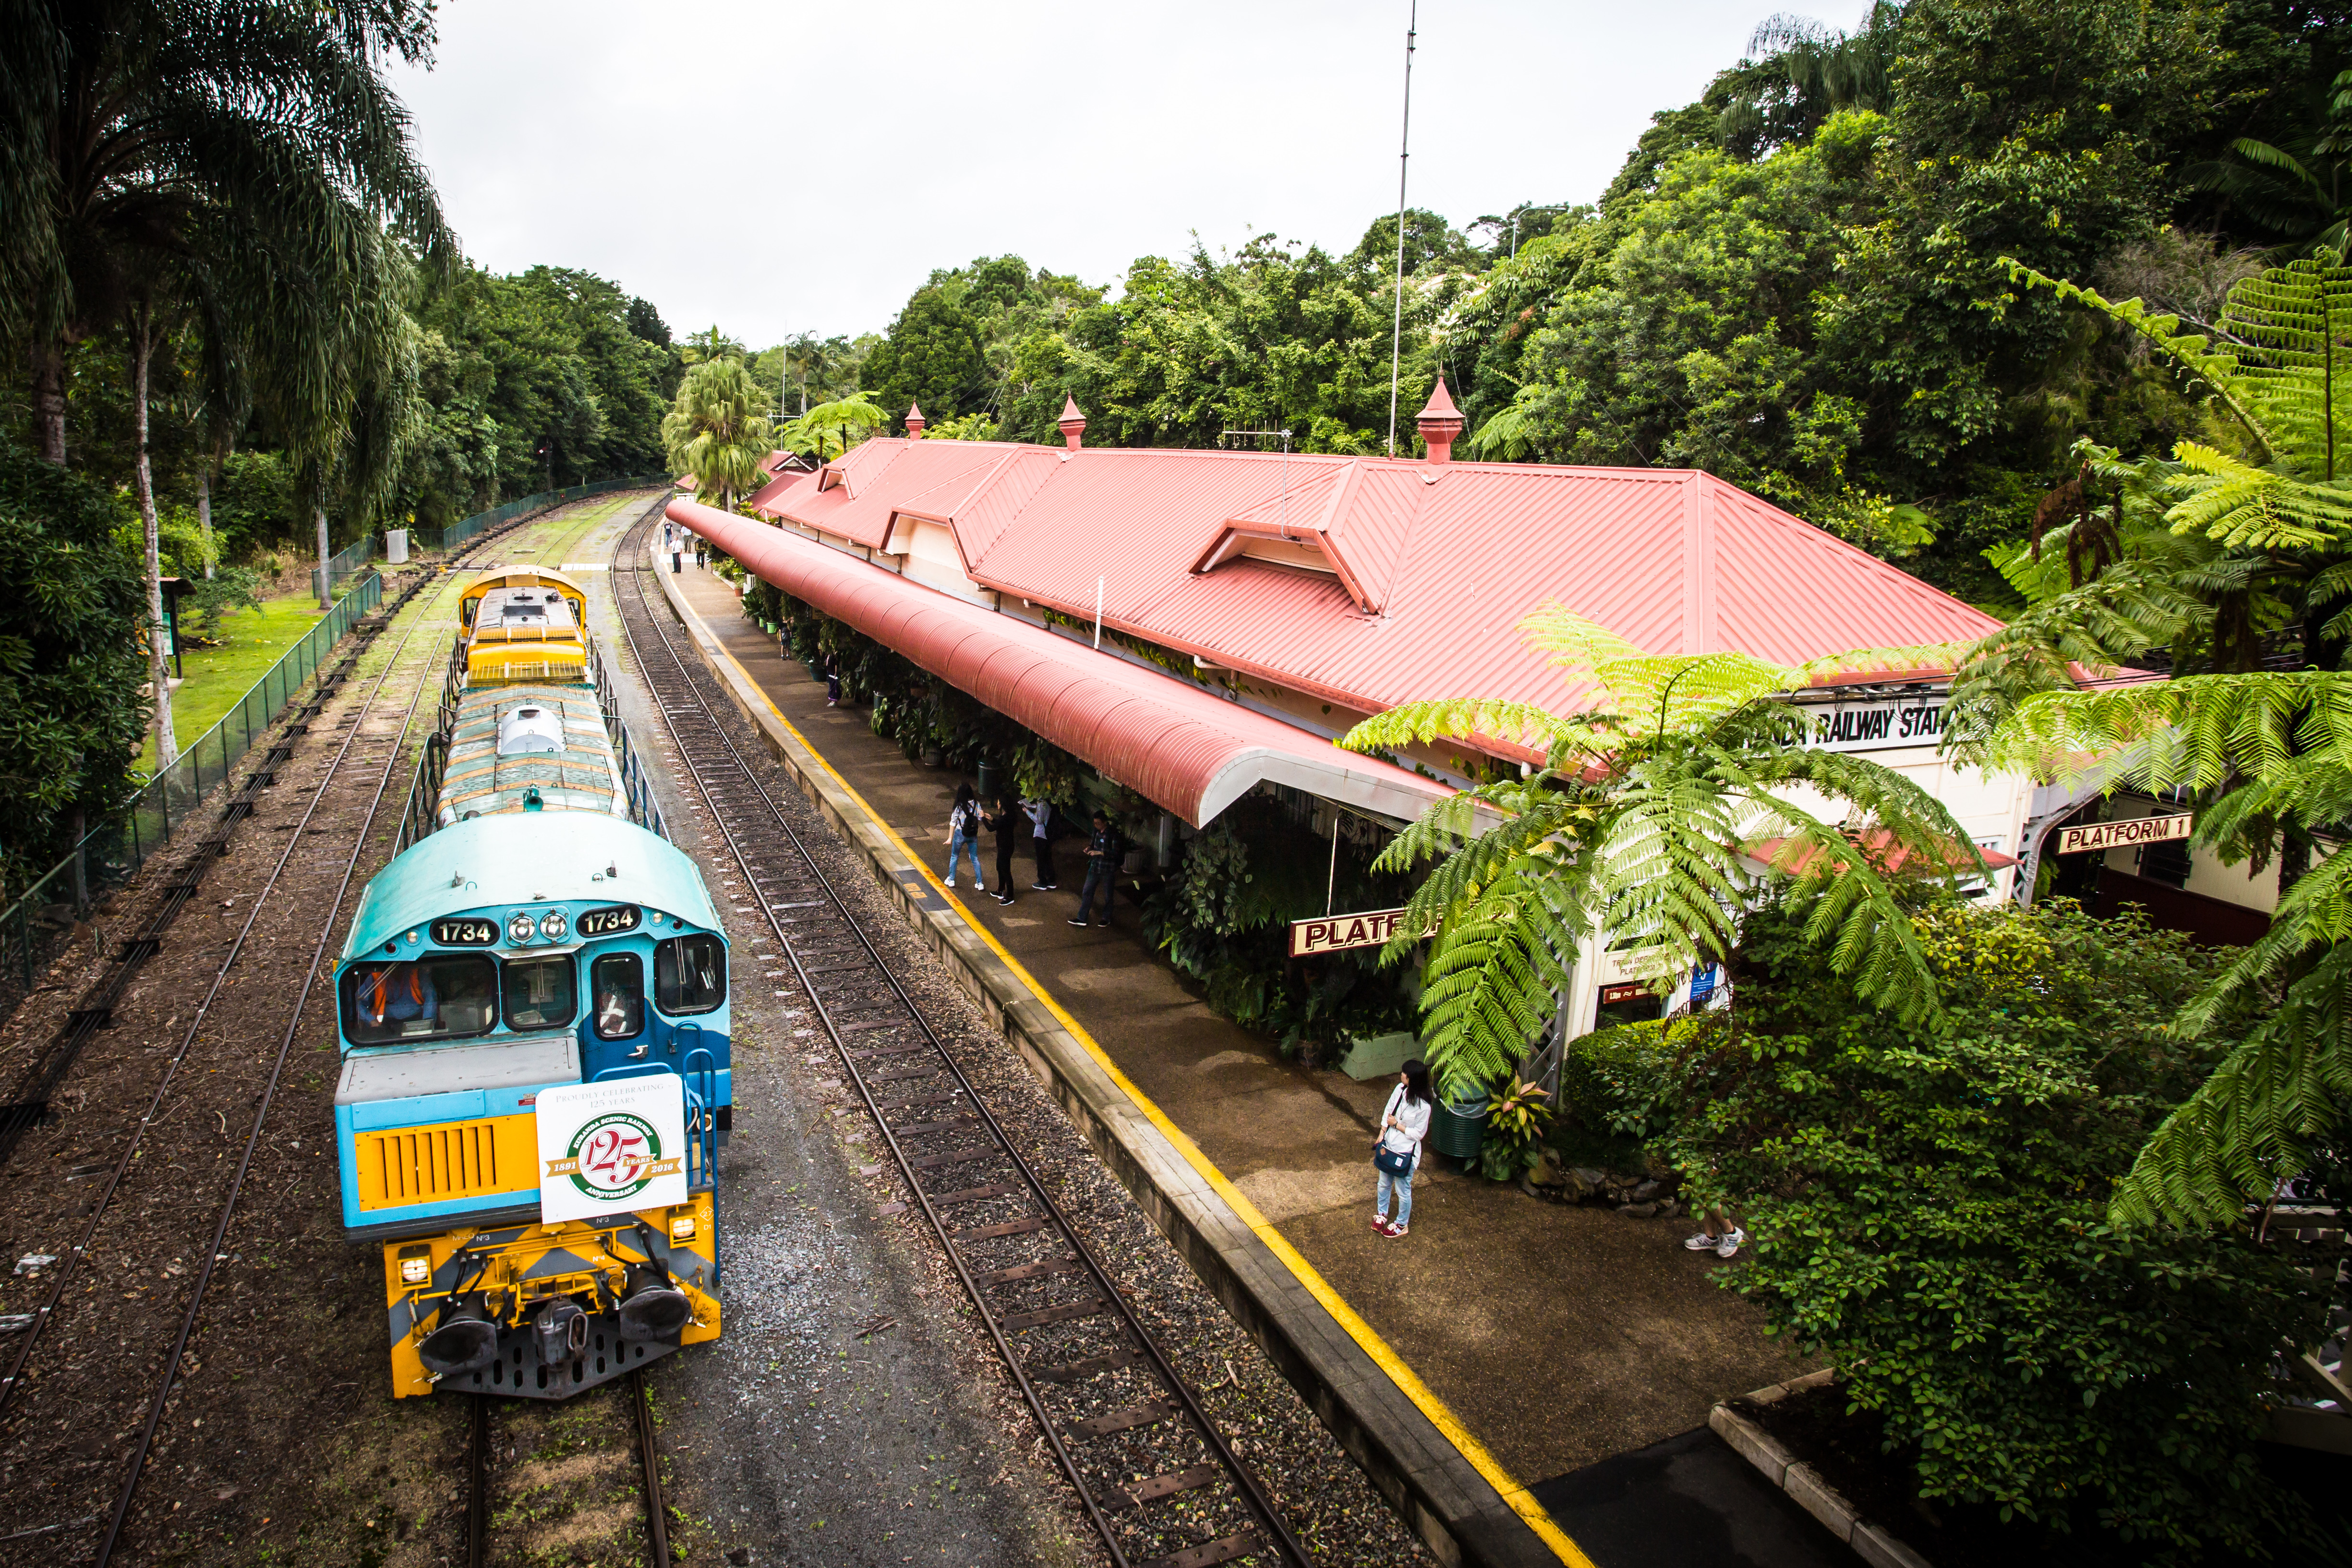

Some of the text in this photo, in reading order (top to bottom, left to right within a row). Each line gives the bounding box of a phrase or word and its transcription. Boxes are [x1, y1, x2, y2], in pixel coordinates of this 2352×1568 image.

[1815, 709, 1895, 744] RAILWAY
[2067, 818, 2185, 851] PLATFORM 1
[585, 909, 633, 933] 1734
[439, 923, 491, 941] 1734
[556, 1083, 664, 1103] PROUDLY CELEBRATING
[591, 1097, 635, 1109] 125 YEARS
[573, 1116, 653, 1149] KURANDA SCENIC RAILWAY
[581, 1129, 644, 1184] 125
[626, 1157, 651, 1165] YEARS
[554, 1161, 576, 1172] 1891
[651, 1163, 674, 1173] 2016
[585, 1184, 638, 1199] ANNIVERSARY
